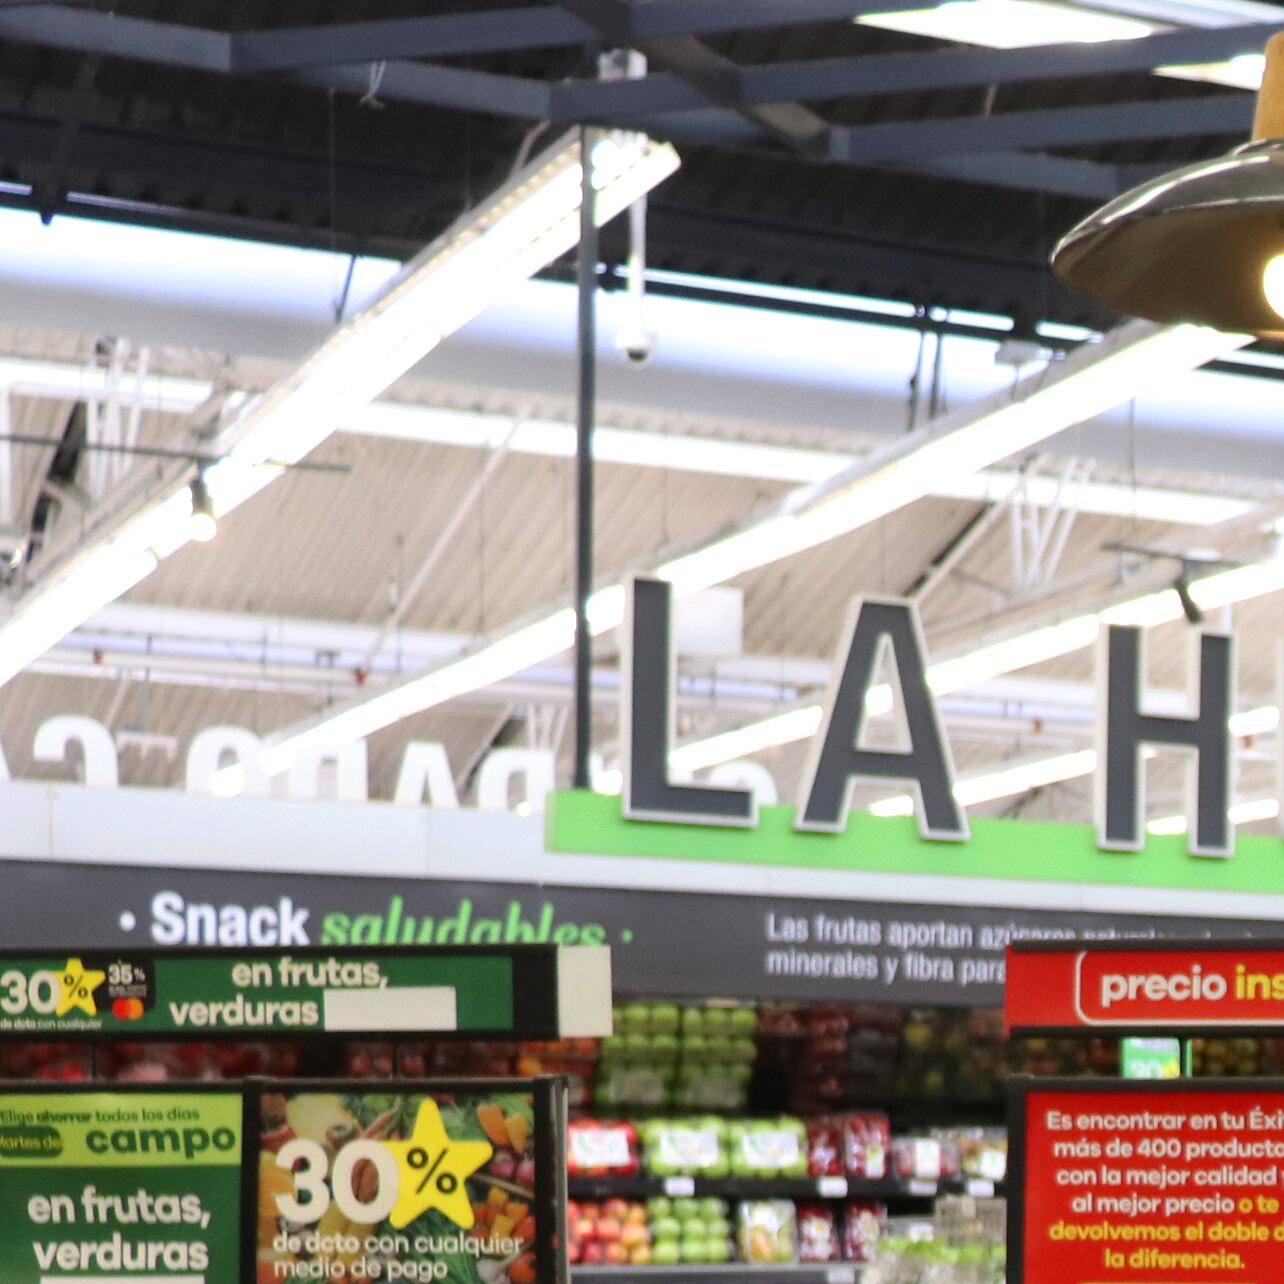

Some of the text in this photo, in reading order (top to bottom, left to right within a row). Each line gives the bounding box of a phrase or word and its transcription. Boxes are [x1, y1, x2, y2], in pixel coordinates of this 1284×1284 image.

[620, 571, 971, 842] LA
[151, 892, 606, 946] Snack saludables
[766, 911, 809, 943] Las
[815, 912, 882, 946] frutas
[888, 920, 973, 951] aportan
[231, 956, 389, 989] en frutas,
[767, 949, 879, 981] minerales
[883, 957, 900, 986] y
[905, 954, 954, 982] fibra
[1101, 964, 1228, 1008] precio
[168, 994, 320, 1026] verduras
[95, 1108, 139, 1123] todos
[142, 1107, 164, 1122] los
[1046, 1111, 1073, 1131] Es
[1076, 1111, 1187, 1131] encontrar
[1190, 1114, 1217, 1131] en
[1220, 1111, 1245, 1131] tu
[85, 1126, 236, 1159] campo
[1053, 1138, 1101, 1158] más
[1105, 1138, 1133, 1158] de
[1136, 1139, 1181, 1158] 400
[1056, 1168, 1097, 1186] con
[1101, 1165, 1121, 1186] la
[1126, 1165, 1190, 1190] mejor
[1194, 1164, 1277, 1186] calidad
[27, 1184, 211, 1229] en frutas,
[1072, 1193, 1280, 1217] al mejor precio o te
[272, 1230, 524, 1259] de dcto con cualquier
[1049, 1220, 1181, 1242] devolvemos
[1185, 1221, 1204, 1241] el
[1208, 1221, 1270, 1241] doble
[33, 1231, 210, 1271] verduras
[1105, 1248, 1246, 1269] la diferencia.
[273, 1256, 448, 1283] medio de pago
